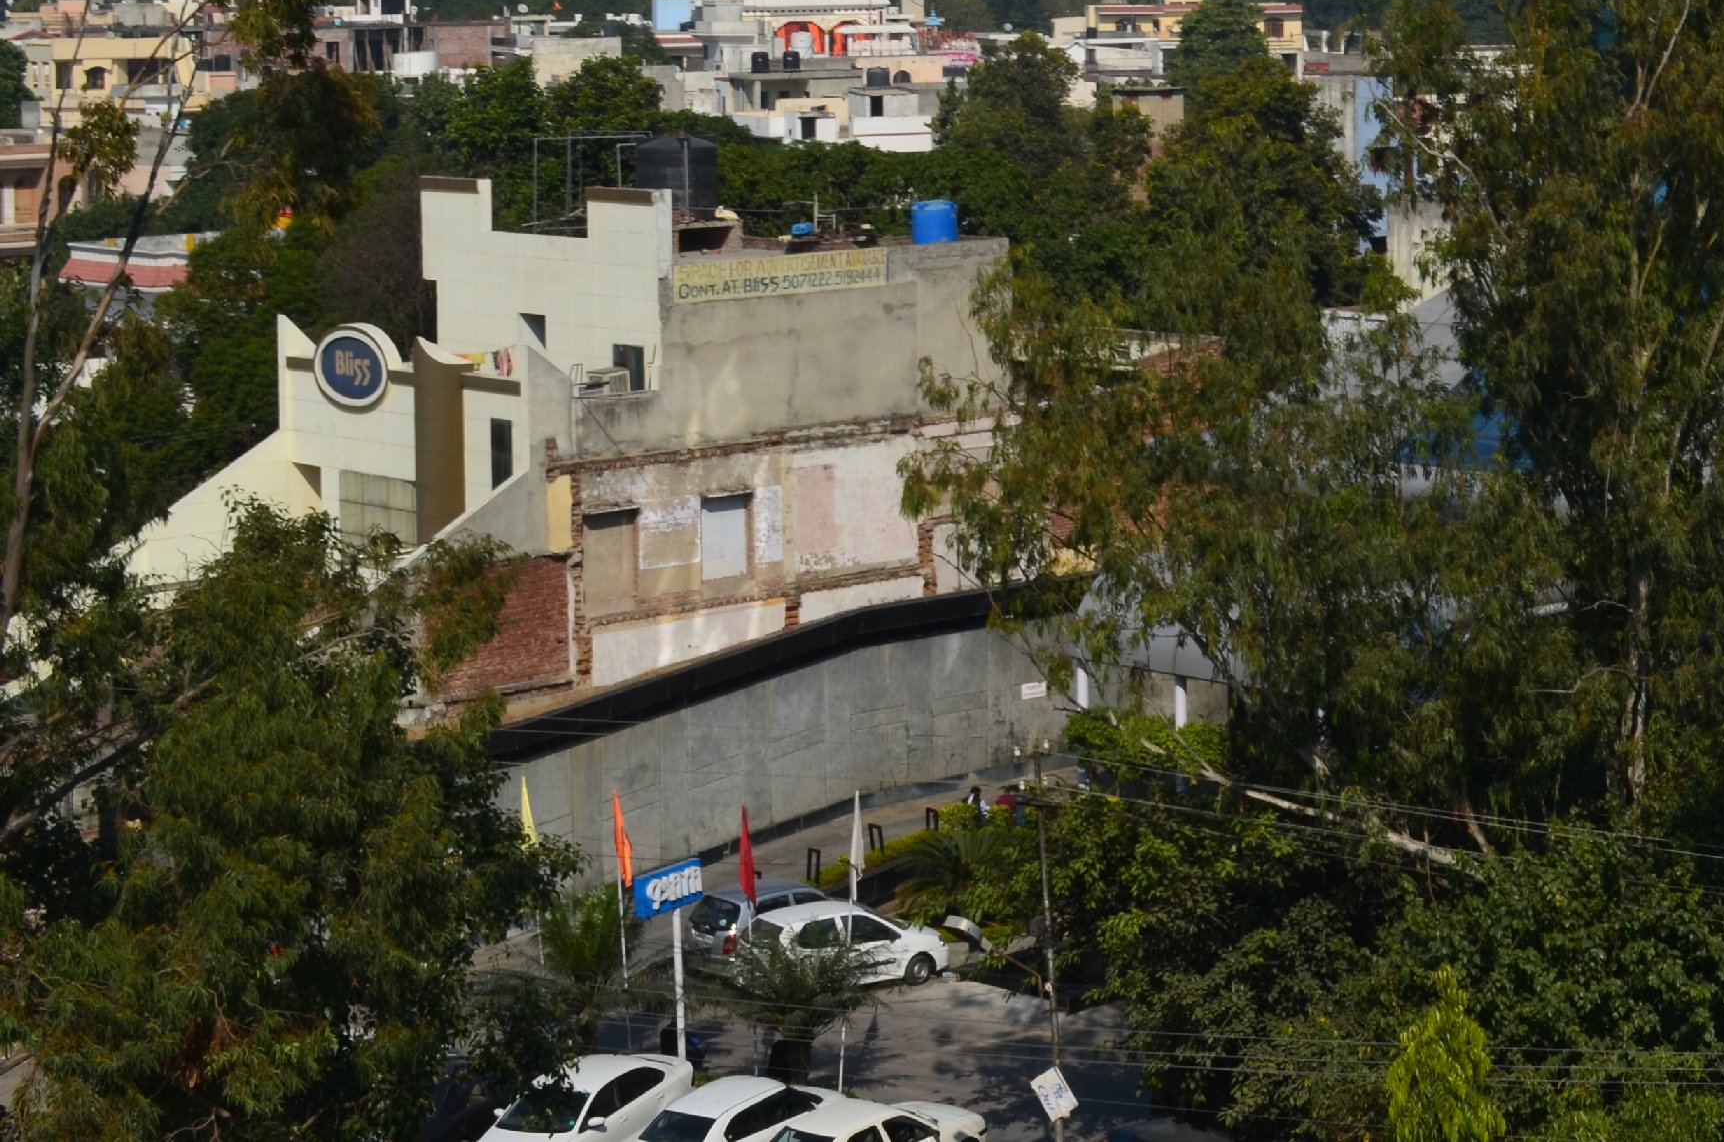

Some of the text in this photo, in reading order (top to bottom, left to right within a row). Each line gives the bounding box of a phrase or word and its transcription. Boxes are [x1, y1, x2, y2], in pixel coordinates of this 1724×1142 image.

[678, 261, 727, 282] SPACE
[729, 259, 752, 278] FOR
[335, 349, 371, 386] Bliss
